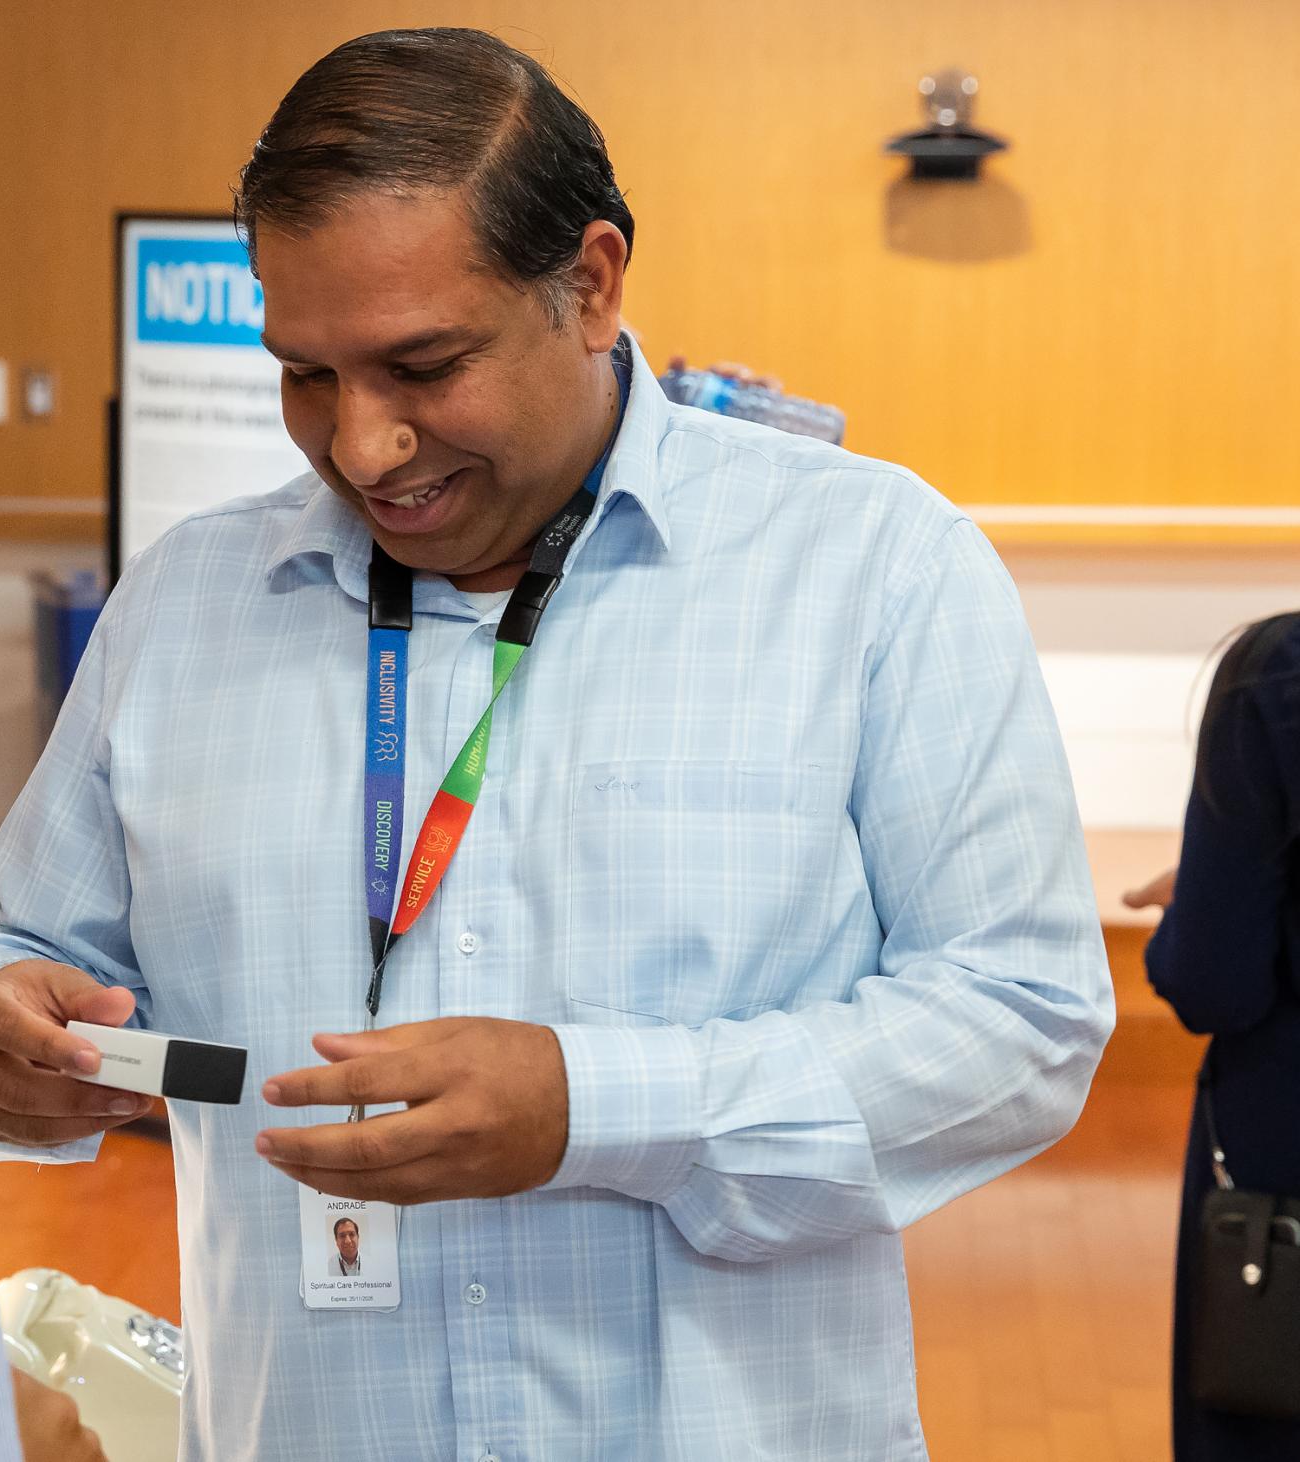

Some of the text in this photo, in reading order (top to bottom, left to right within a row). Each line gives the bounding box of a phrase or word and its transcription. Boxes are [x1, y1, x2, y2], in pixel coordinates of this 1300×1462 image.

[379, 650, 397, 724] INCLUSIVITY
[375, 801, 393, 871] DISCOVERY
[406, 855, 436, 908] SERVICE
[327, 1200, 366, 1210] ANDRADE
[310, 1280, 392, 1290] Spiritual Care Professional
